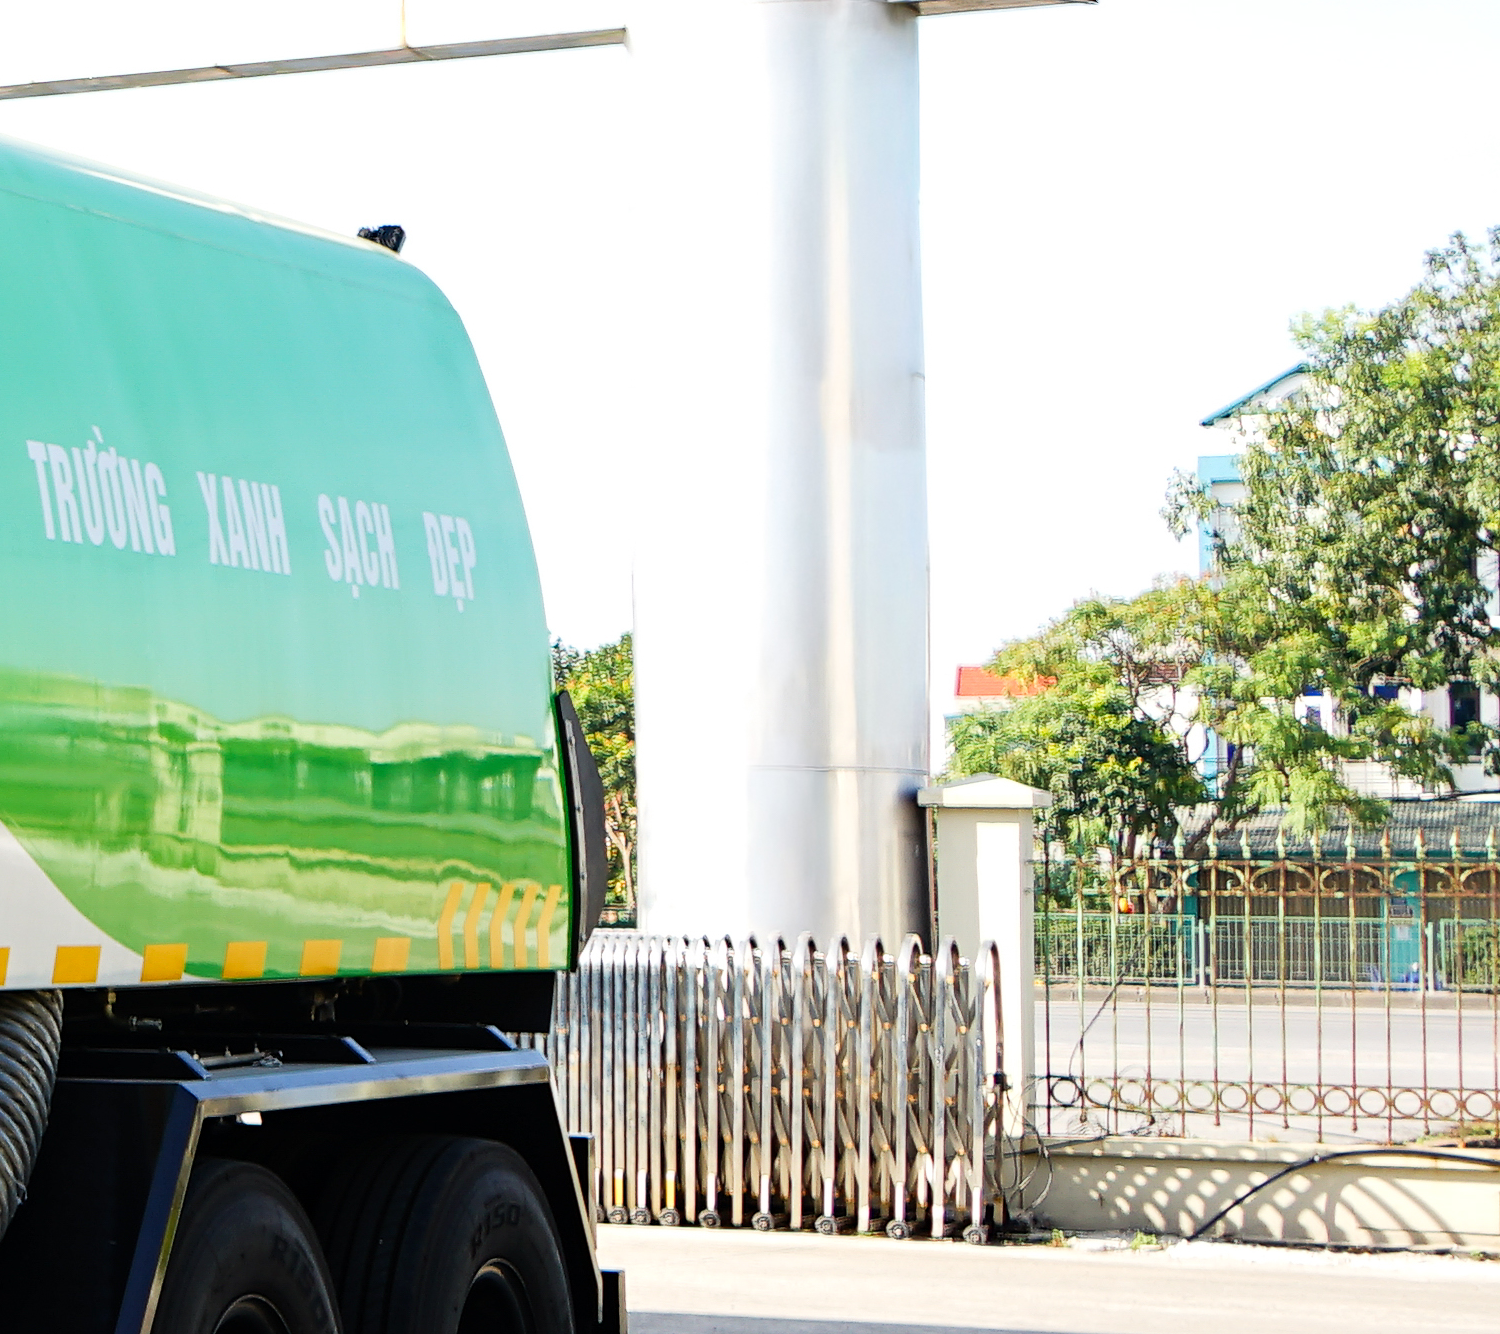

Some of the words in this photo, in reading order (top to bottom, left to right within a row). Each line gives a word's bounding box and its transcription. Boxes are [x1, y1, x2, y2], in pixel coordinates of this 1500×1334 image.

[196, 471, 292, 576] XANH
[317, 493, 399, 599] SẠCH
[421, 511, 477, 613] ĐẸP
